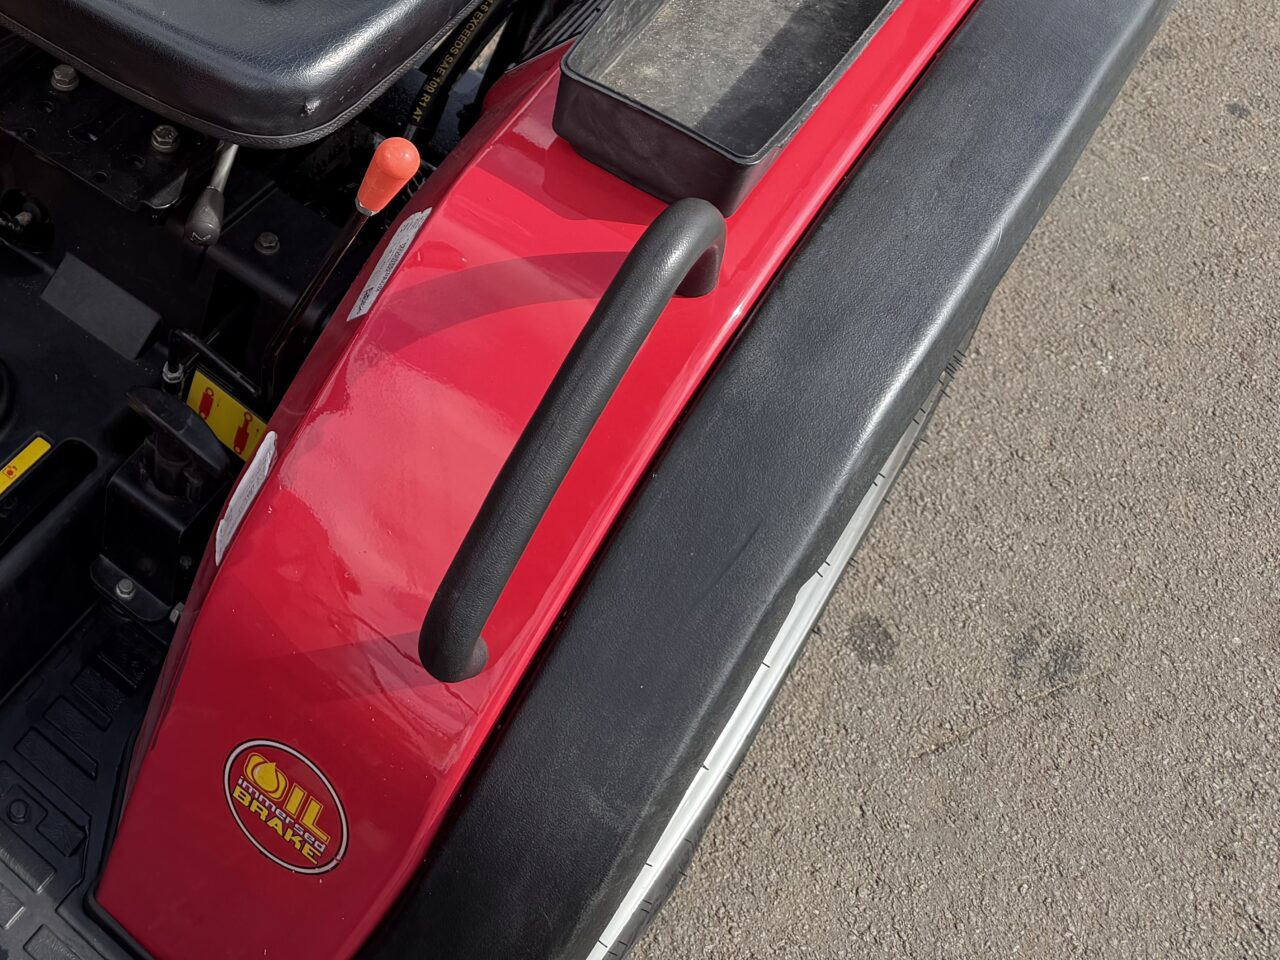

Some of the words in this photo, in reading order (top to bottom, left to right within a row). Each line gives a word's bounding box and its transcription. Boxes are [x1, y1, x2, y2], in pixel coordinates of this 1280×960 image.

[450, 11, 483, 55] EXCEEDS
[436, 54, 454, 75] SAE
[419, 93, 431, 107] R1
[425, 77, 441, 93] 100
[412, 107, 424, 122] AT
[237, 776, 326, 852] immersed
[244, 752, 331, 844] OIL
[233, 785, 322, 864] BRAKE
